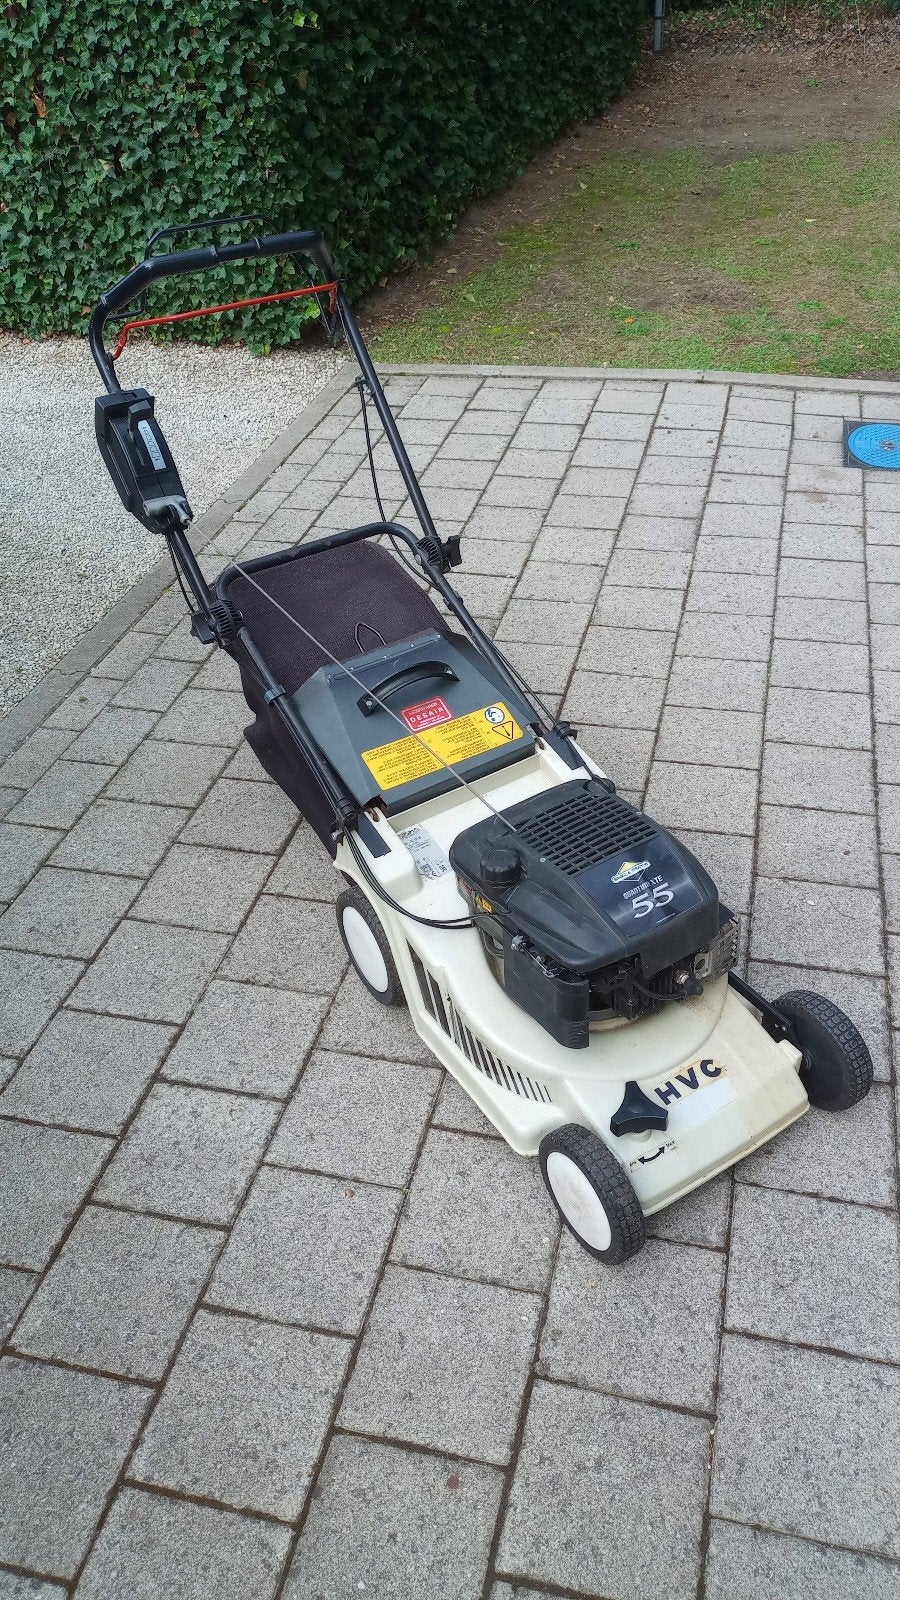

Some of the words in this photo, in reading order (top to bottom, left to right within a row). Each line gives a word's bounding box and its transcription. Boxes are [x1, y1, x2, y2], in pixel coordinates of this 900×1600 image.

[410, 706, 444, 723] DESAIR
[632, 883, 674, 918] 55
[654, 1059, 722, 1106] HVC
